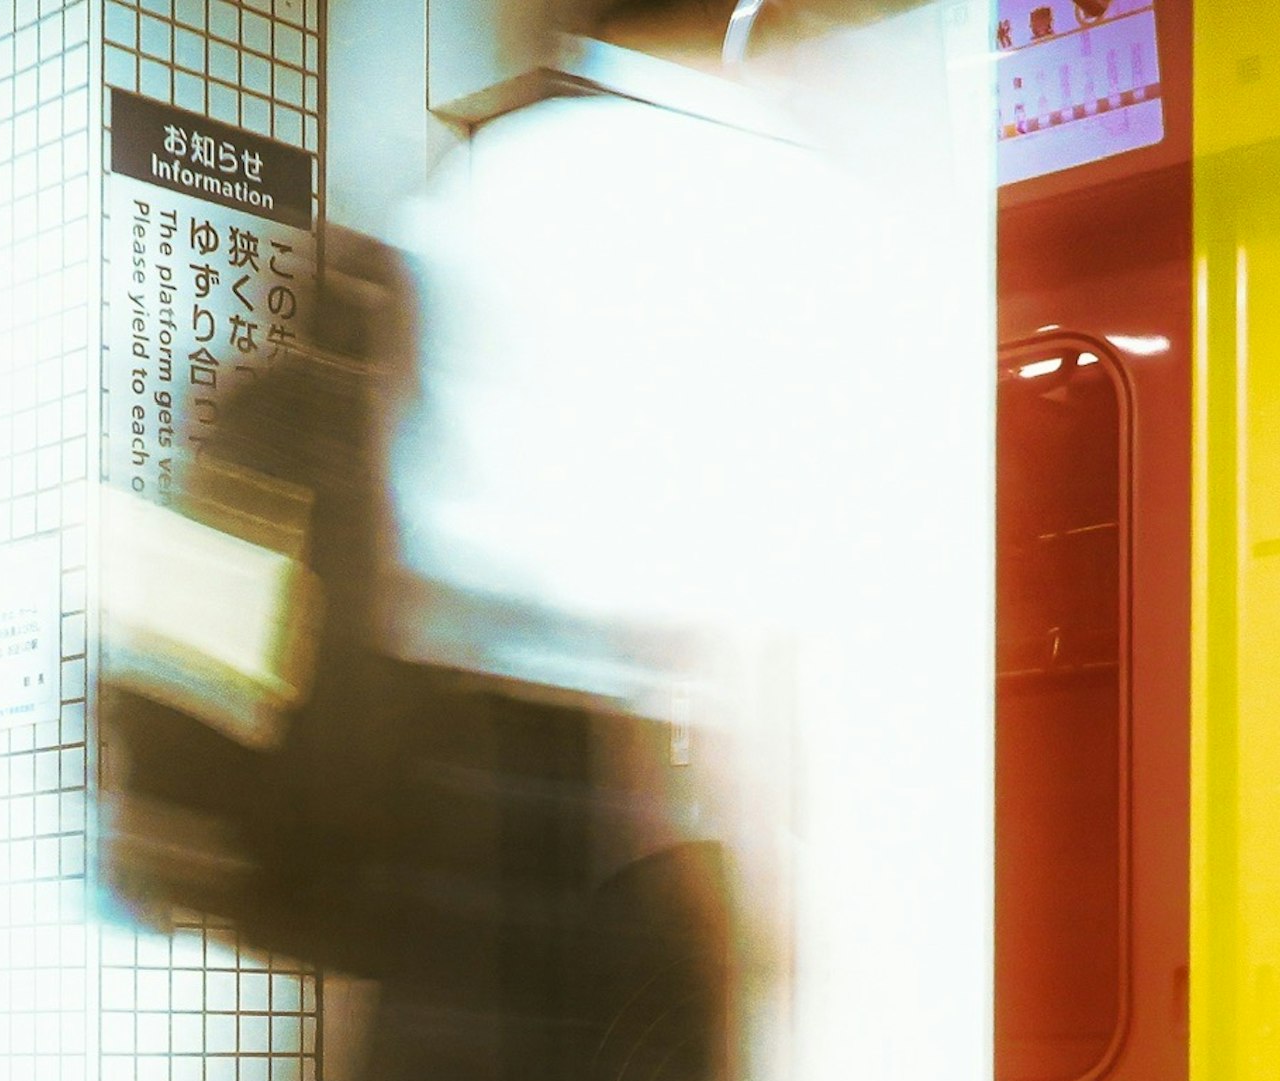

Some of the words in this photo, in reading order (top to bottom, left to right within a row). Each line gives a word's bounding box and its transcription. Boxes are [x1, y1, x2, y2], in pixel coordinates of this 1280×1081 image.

[151, 152, 274, 210] Information
[164, 124, 264, 183] お知らせ
[132, 199, 151, 284] Please
[159, 209, 177, 256] The
[127, 291, 150, 360] yield
[155, 264, 177, 382] platform
[132, 368, 148, 395] to
[132, 405, 150, 466] each
[154, 391, 174, 448] gets
